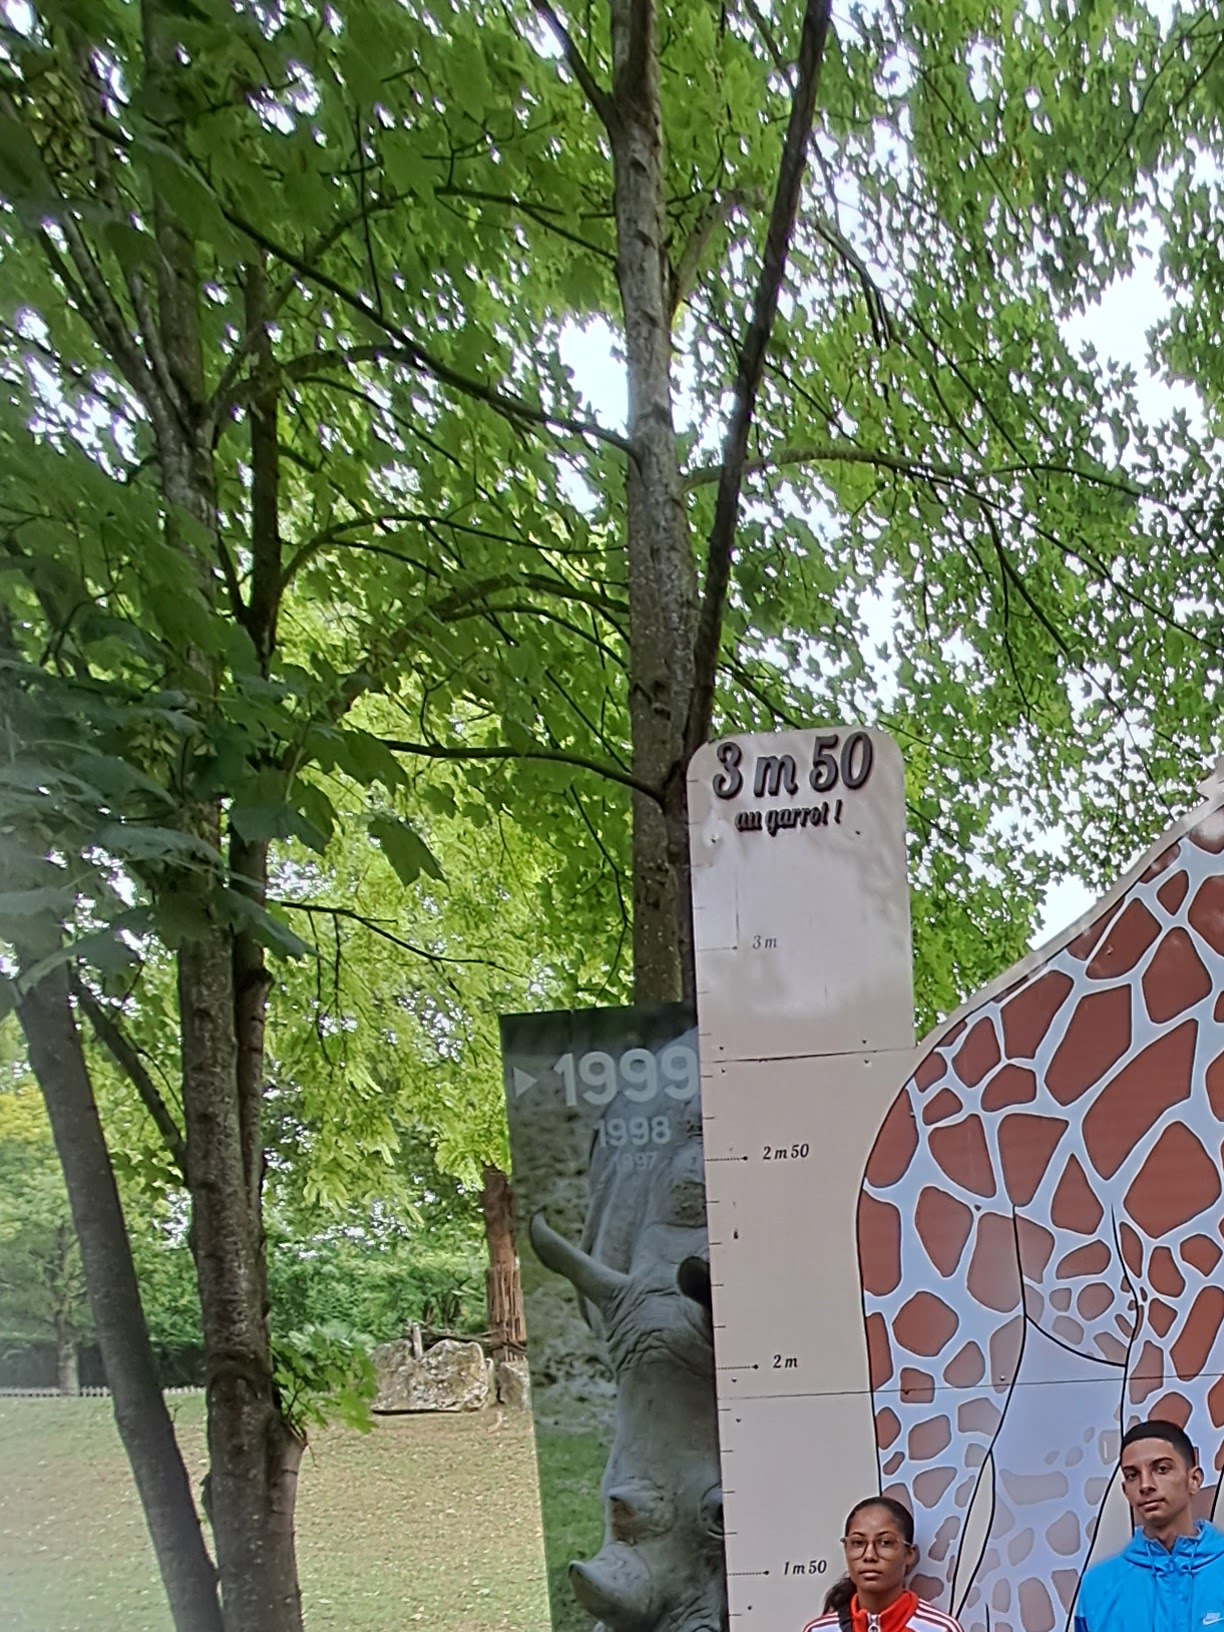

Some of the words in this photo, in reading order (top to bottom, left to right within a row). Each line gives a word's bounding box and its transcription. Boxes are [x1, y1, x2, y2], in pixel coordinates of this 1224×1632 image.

[712, 741, 743, 800] 3
[754, 754, 798, 797] m
[809, 731, 874, 793] 50
[734, 810, 763, 832] au
[765, 802, 829, 837] garrot
[834, 799, 843, 824] !
[752, 935, 762, 949] 3
[764, 938, 777, 948] m
[554, 1045, 699, 1107] 1999
[593, 1116, 672, 1148] 1998
[763, 1146, 771, 1160] 2
[774, 1149, 787, 1160] m
[791, 1143, 809, 1158] 50
[773, 1354, 782, 1369] 2
[785, 1357, 798, 1368] m
[792, 1564, 805, 1575] m
[808, 1559, 827, 1575] 50
